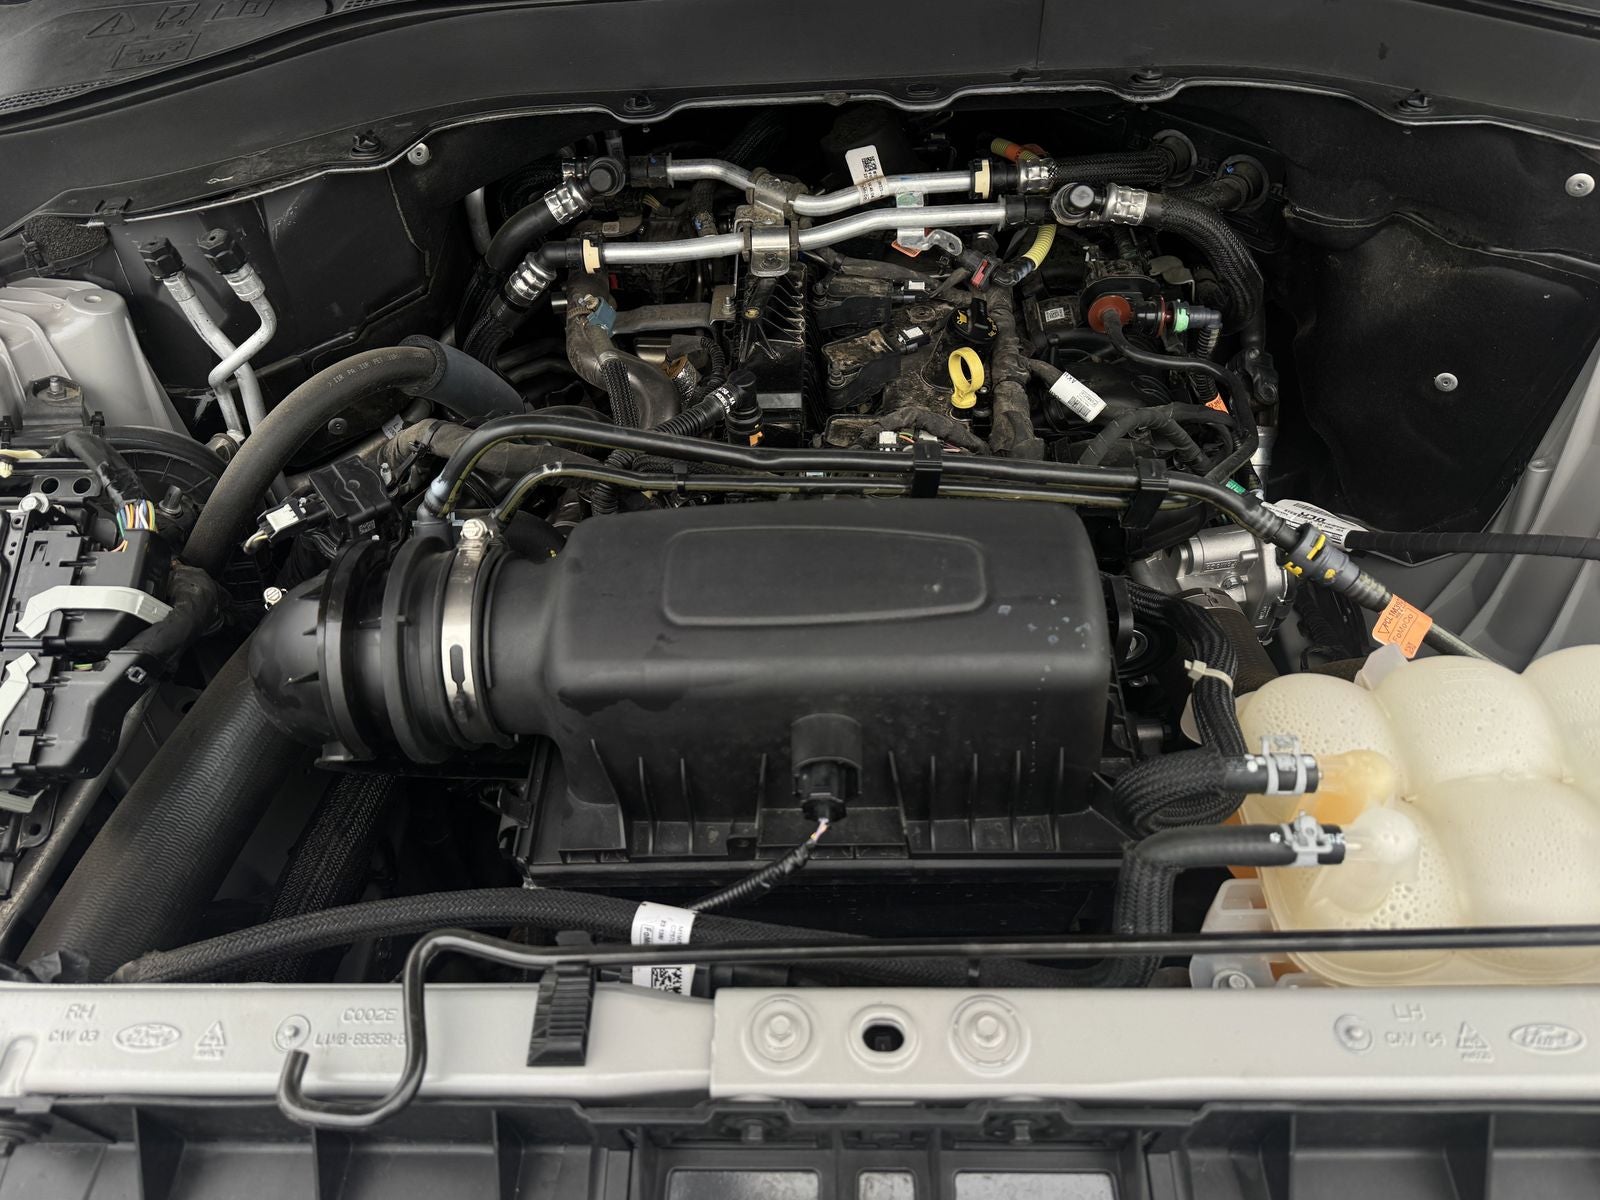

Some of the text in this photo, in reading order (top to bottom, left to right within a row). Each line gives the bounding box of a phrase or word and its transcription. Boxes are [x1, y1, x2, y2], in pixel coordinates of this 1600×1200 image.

[1393, 613, 1414, 643] FoMoCo
[65, 1003, 96, 1020] RH
[1391, 1003, 1425, 1020] LH
